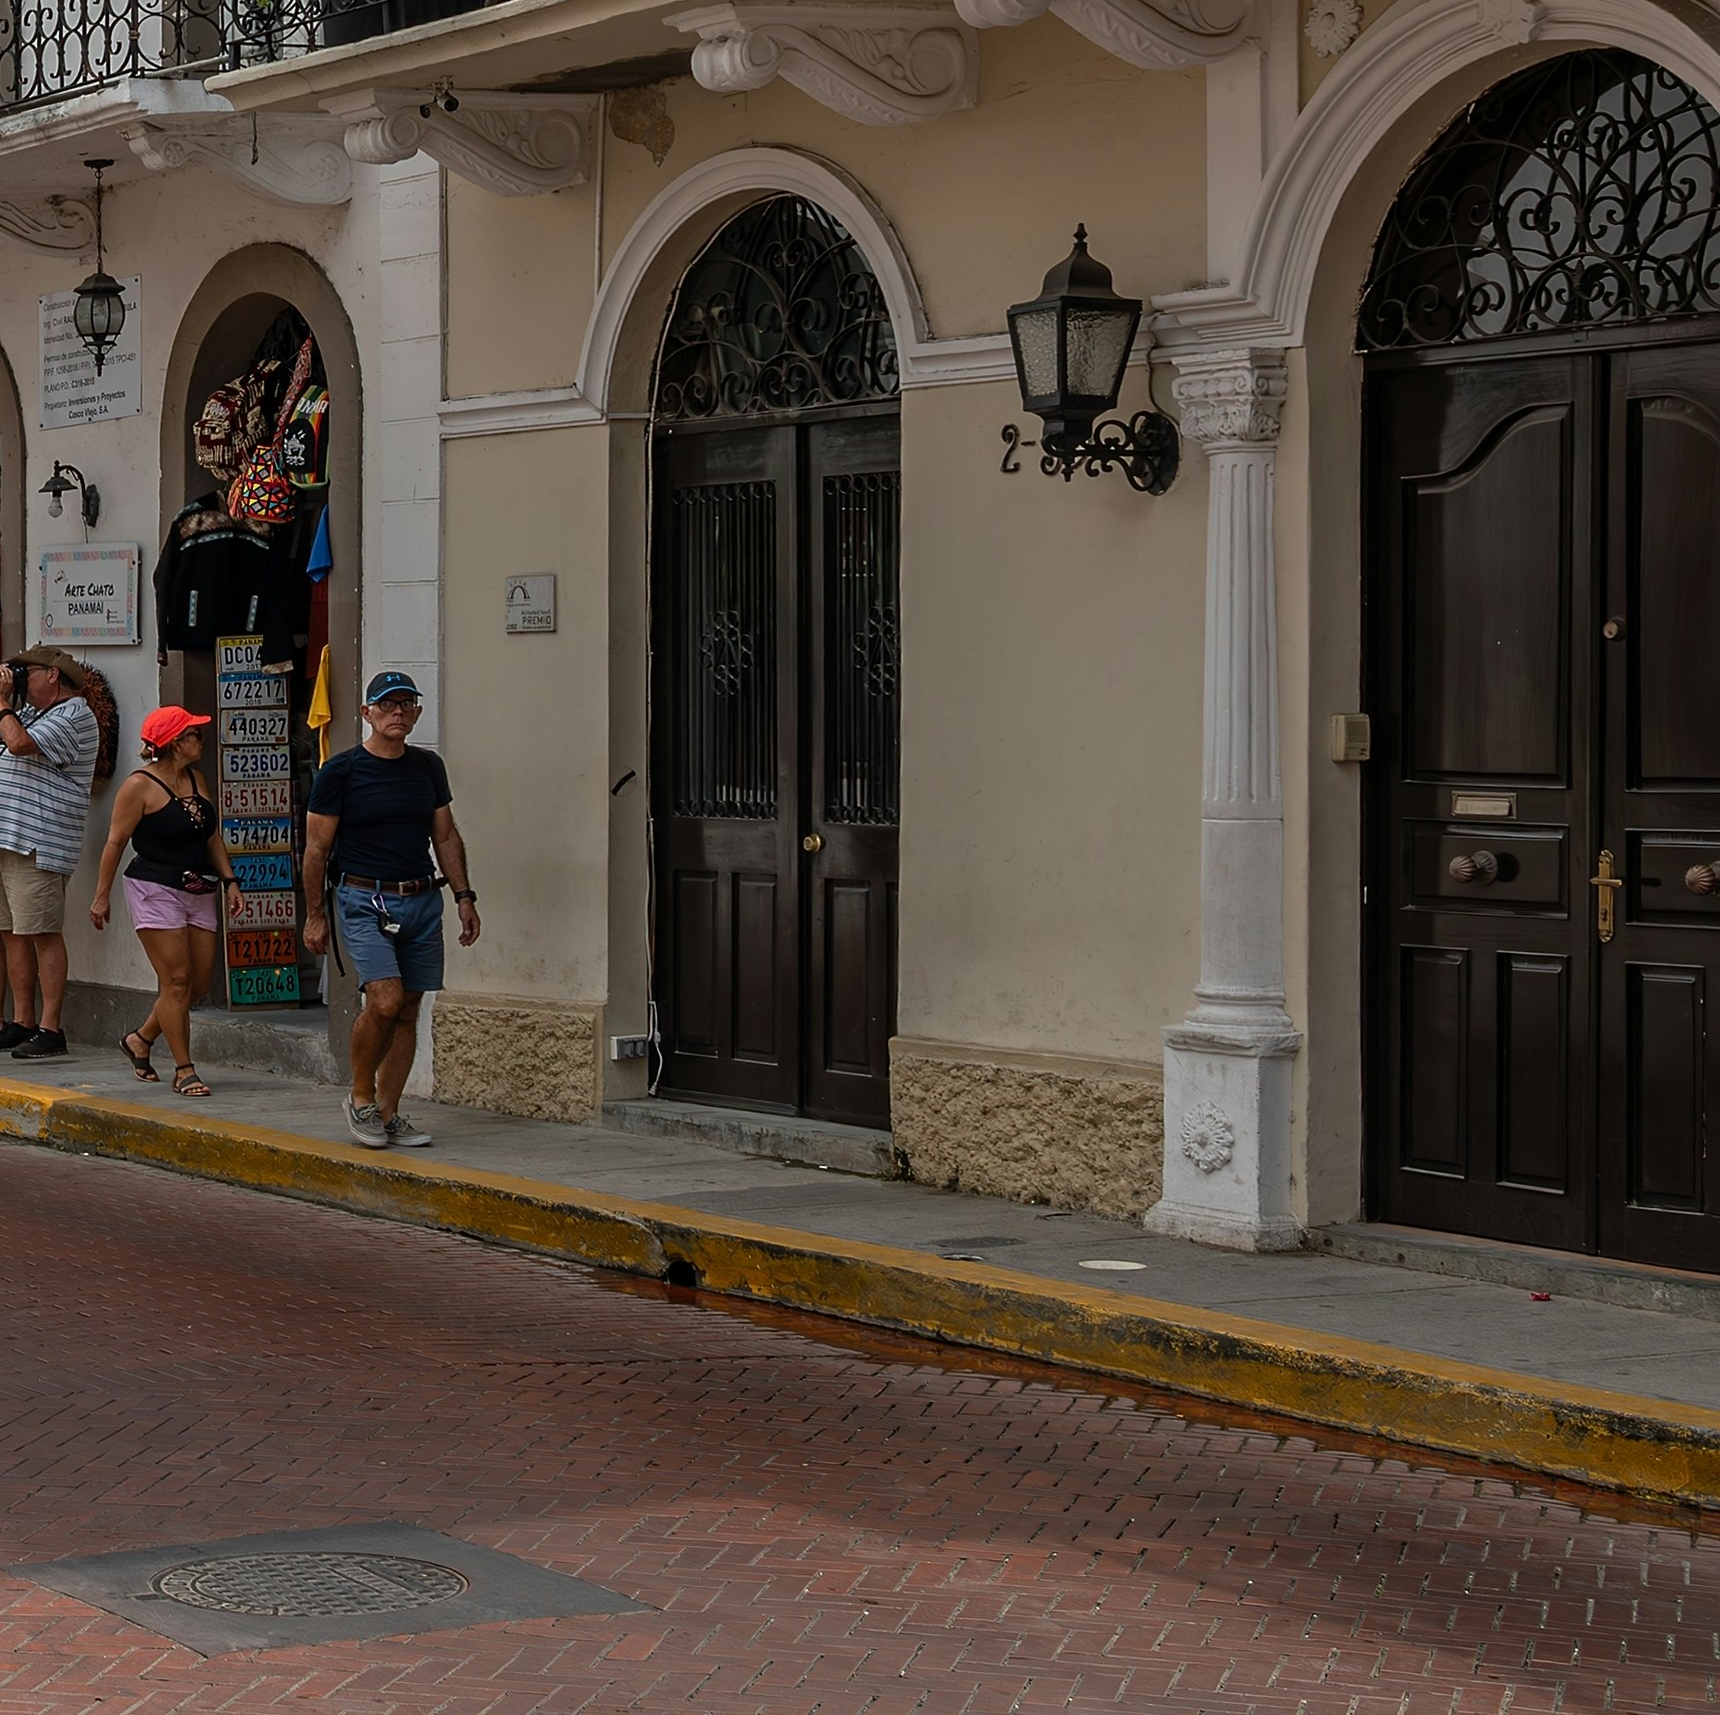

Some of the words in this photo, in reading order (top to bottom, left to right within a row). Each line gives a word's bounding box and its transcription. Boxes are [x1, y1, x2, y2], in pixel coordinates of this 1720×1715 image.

[224, 680, 282, 700] 672217
[229, 717, 286, 736] 440327
[230, 754, 289, 773] 523602
[224, 788, 288, 808] 8-51514
[230, 826, 289, 845] 574704
[232, 938, 292, 958] T21722
[235, 974, 295, 996] T20648
